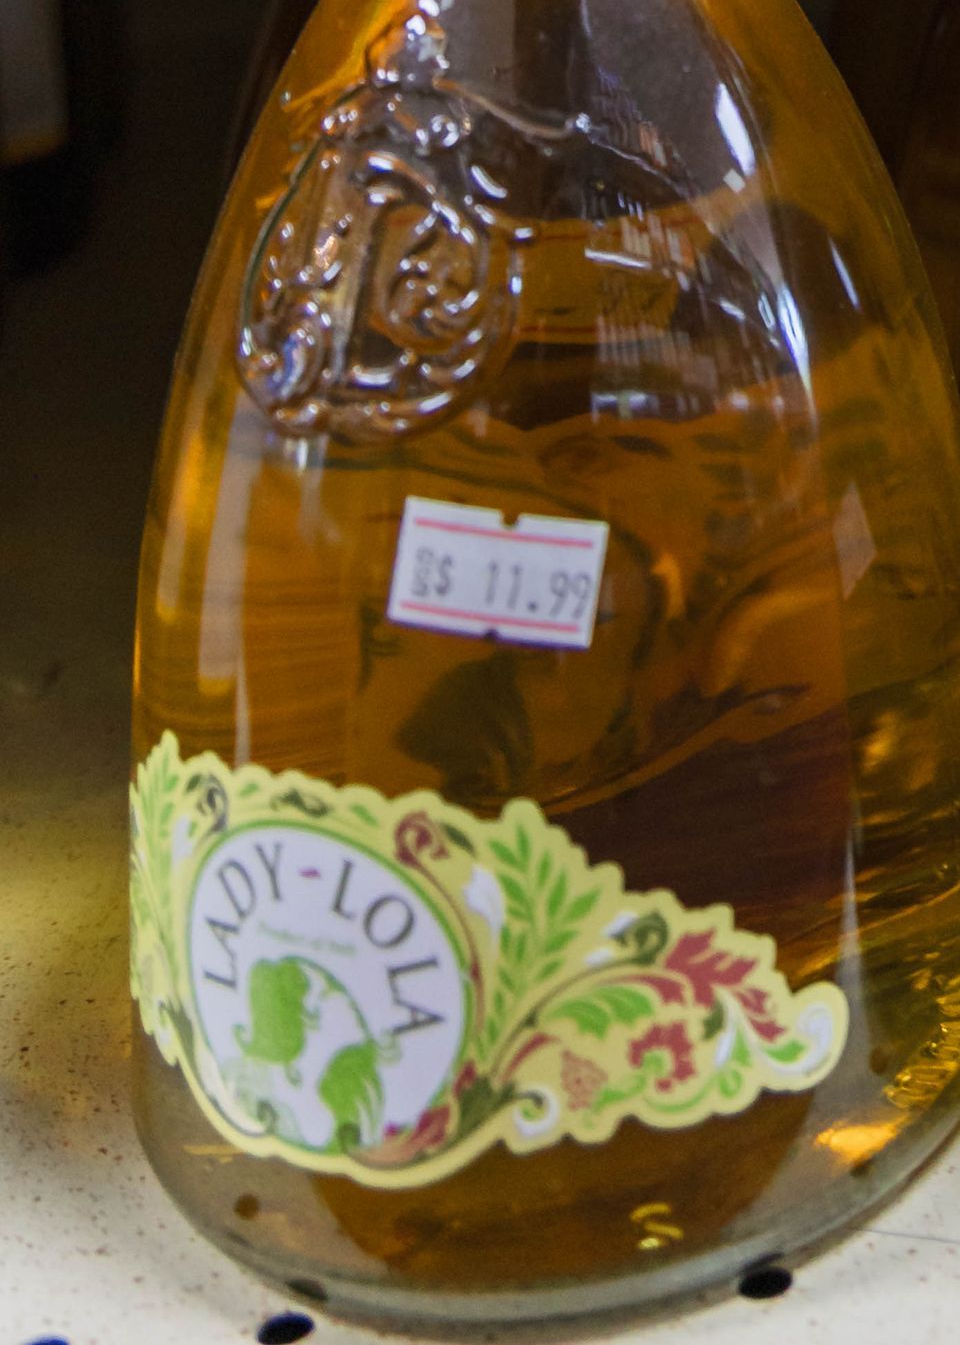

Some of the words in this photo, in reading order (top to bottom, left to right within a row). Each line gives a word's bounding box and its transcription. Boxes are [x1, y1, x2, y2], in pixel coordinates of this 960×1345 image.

[484, 559, 592, 621] 11.99
[203, 841, 283, 991] LADY
[331, 858, 447, 1038] LOLA
